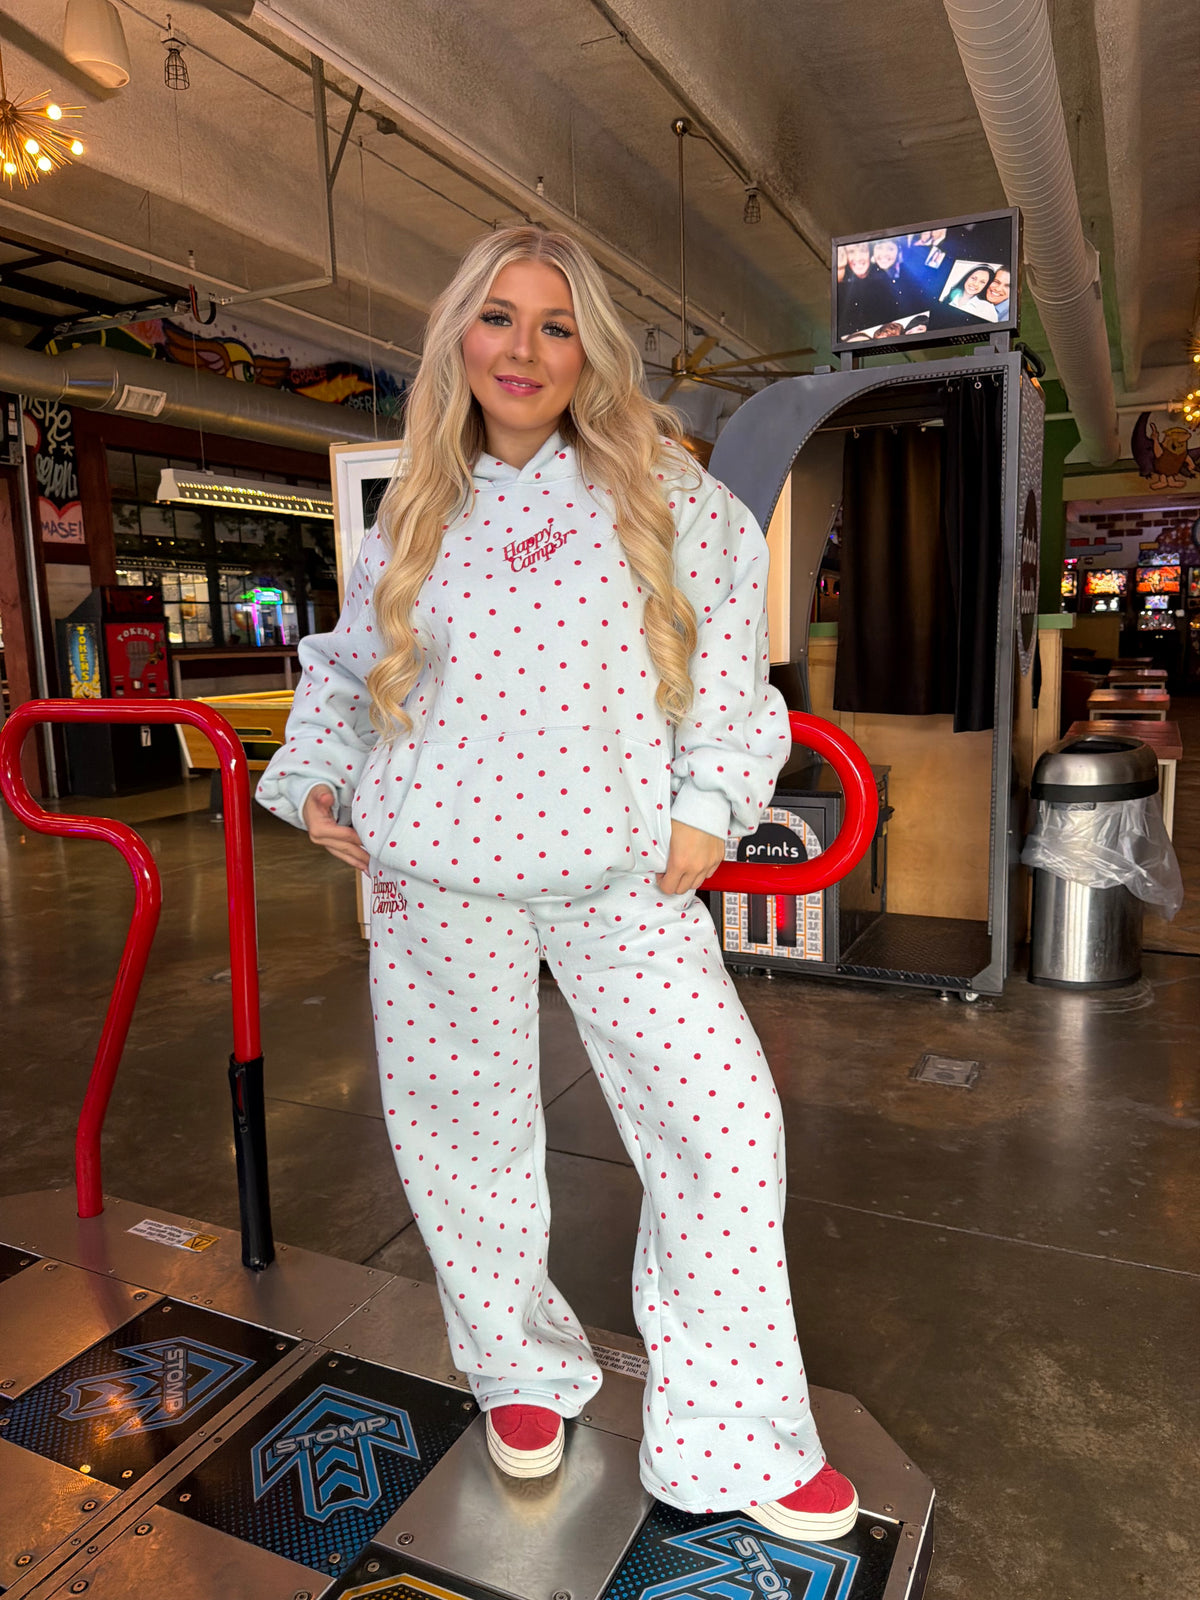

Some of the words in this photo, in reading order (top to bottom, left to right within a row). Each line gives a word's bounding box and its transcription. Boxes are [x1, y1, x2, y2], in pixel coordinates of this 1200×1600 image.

[502, 524, 553, 561] Happy
[116, 627, 156, 642] TOKENS
[76, 626, 90, 681] TOKENS
[745, 841, 799, 862] prints
[165, 1348, 185, 1413] STOMP
[275, 1418, 387, 1455] STOMP
